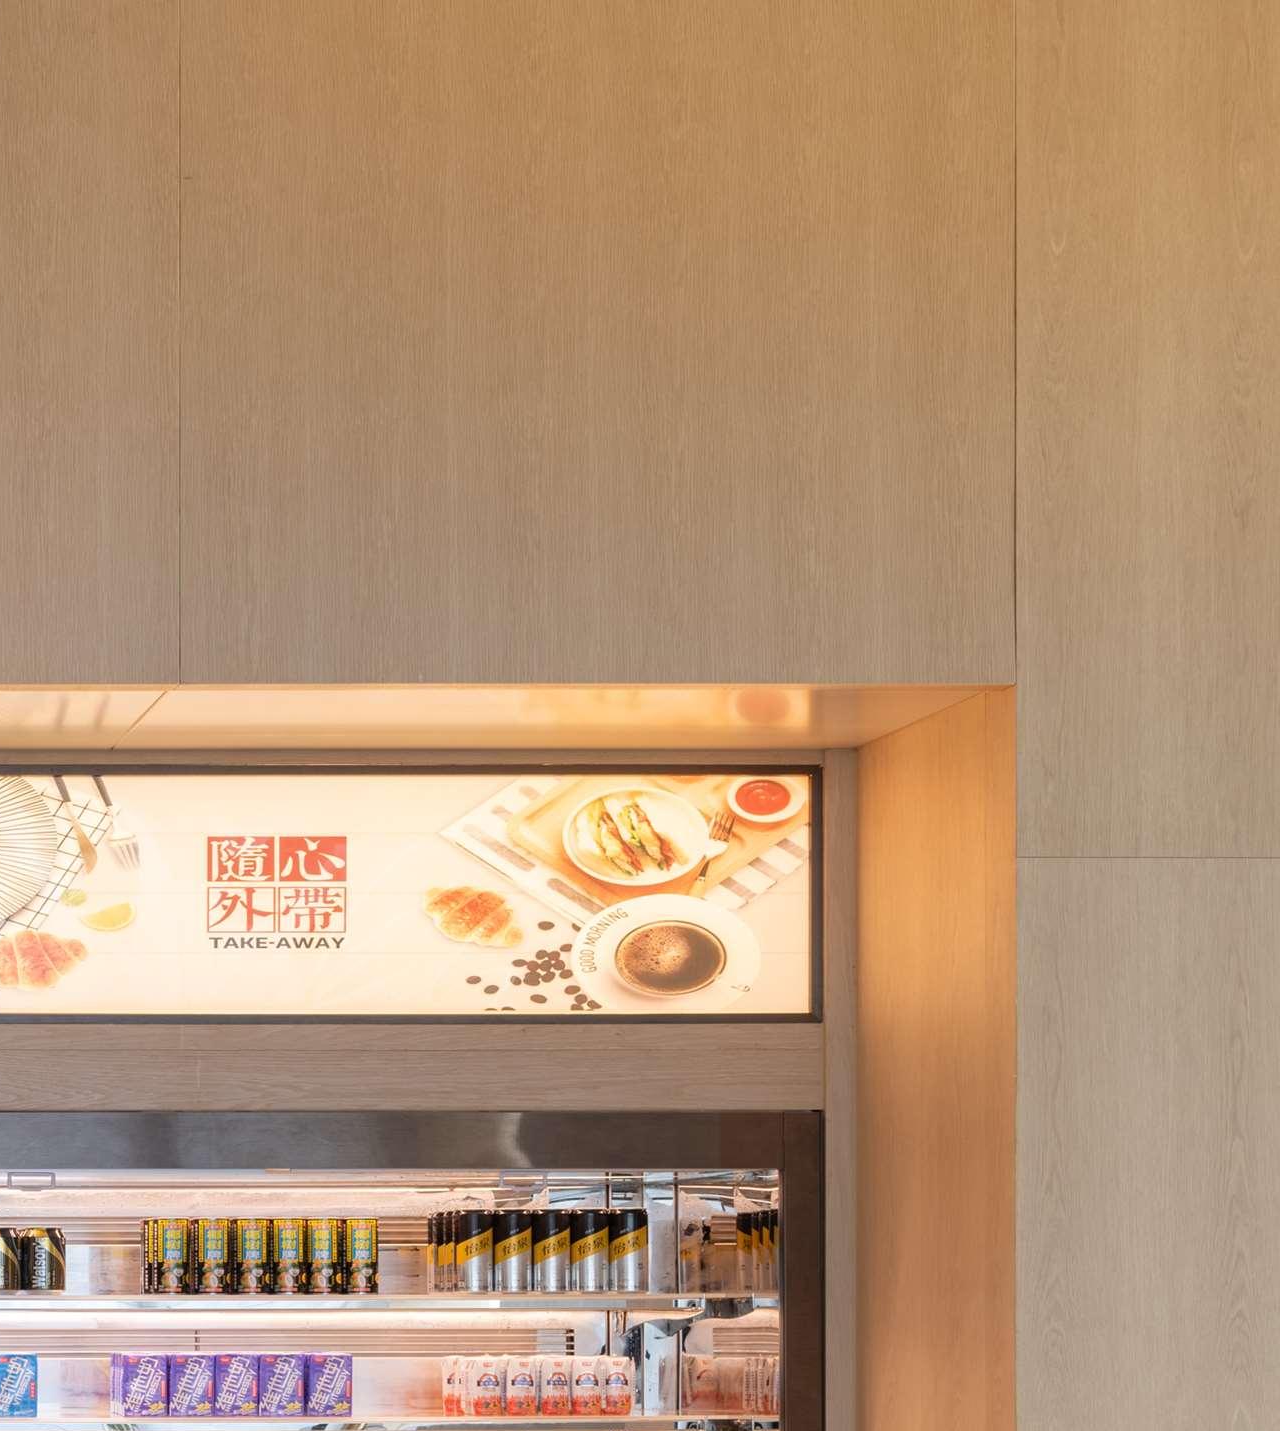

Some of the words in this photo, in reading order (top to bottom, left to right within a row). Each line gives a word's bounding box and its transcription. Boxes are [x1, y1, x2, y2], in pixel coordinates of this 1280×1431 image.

[209, 837, 345, 882] 隨心
[208, 887, 345, 932] 外帶
[583, 907, 629, 947] MORNING
[209, 937, 345, 949] TAKE-AWAY
[579, 947, 598, 973] GOOD
